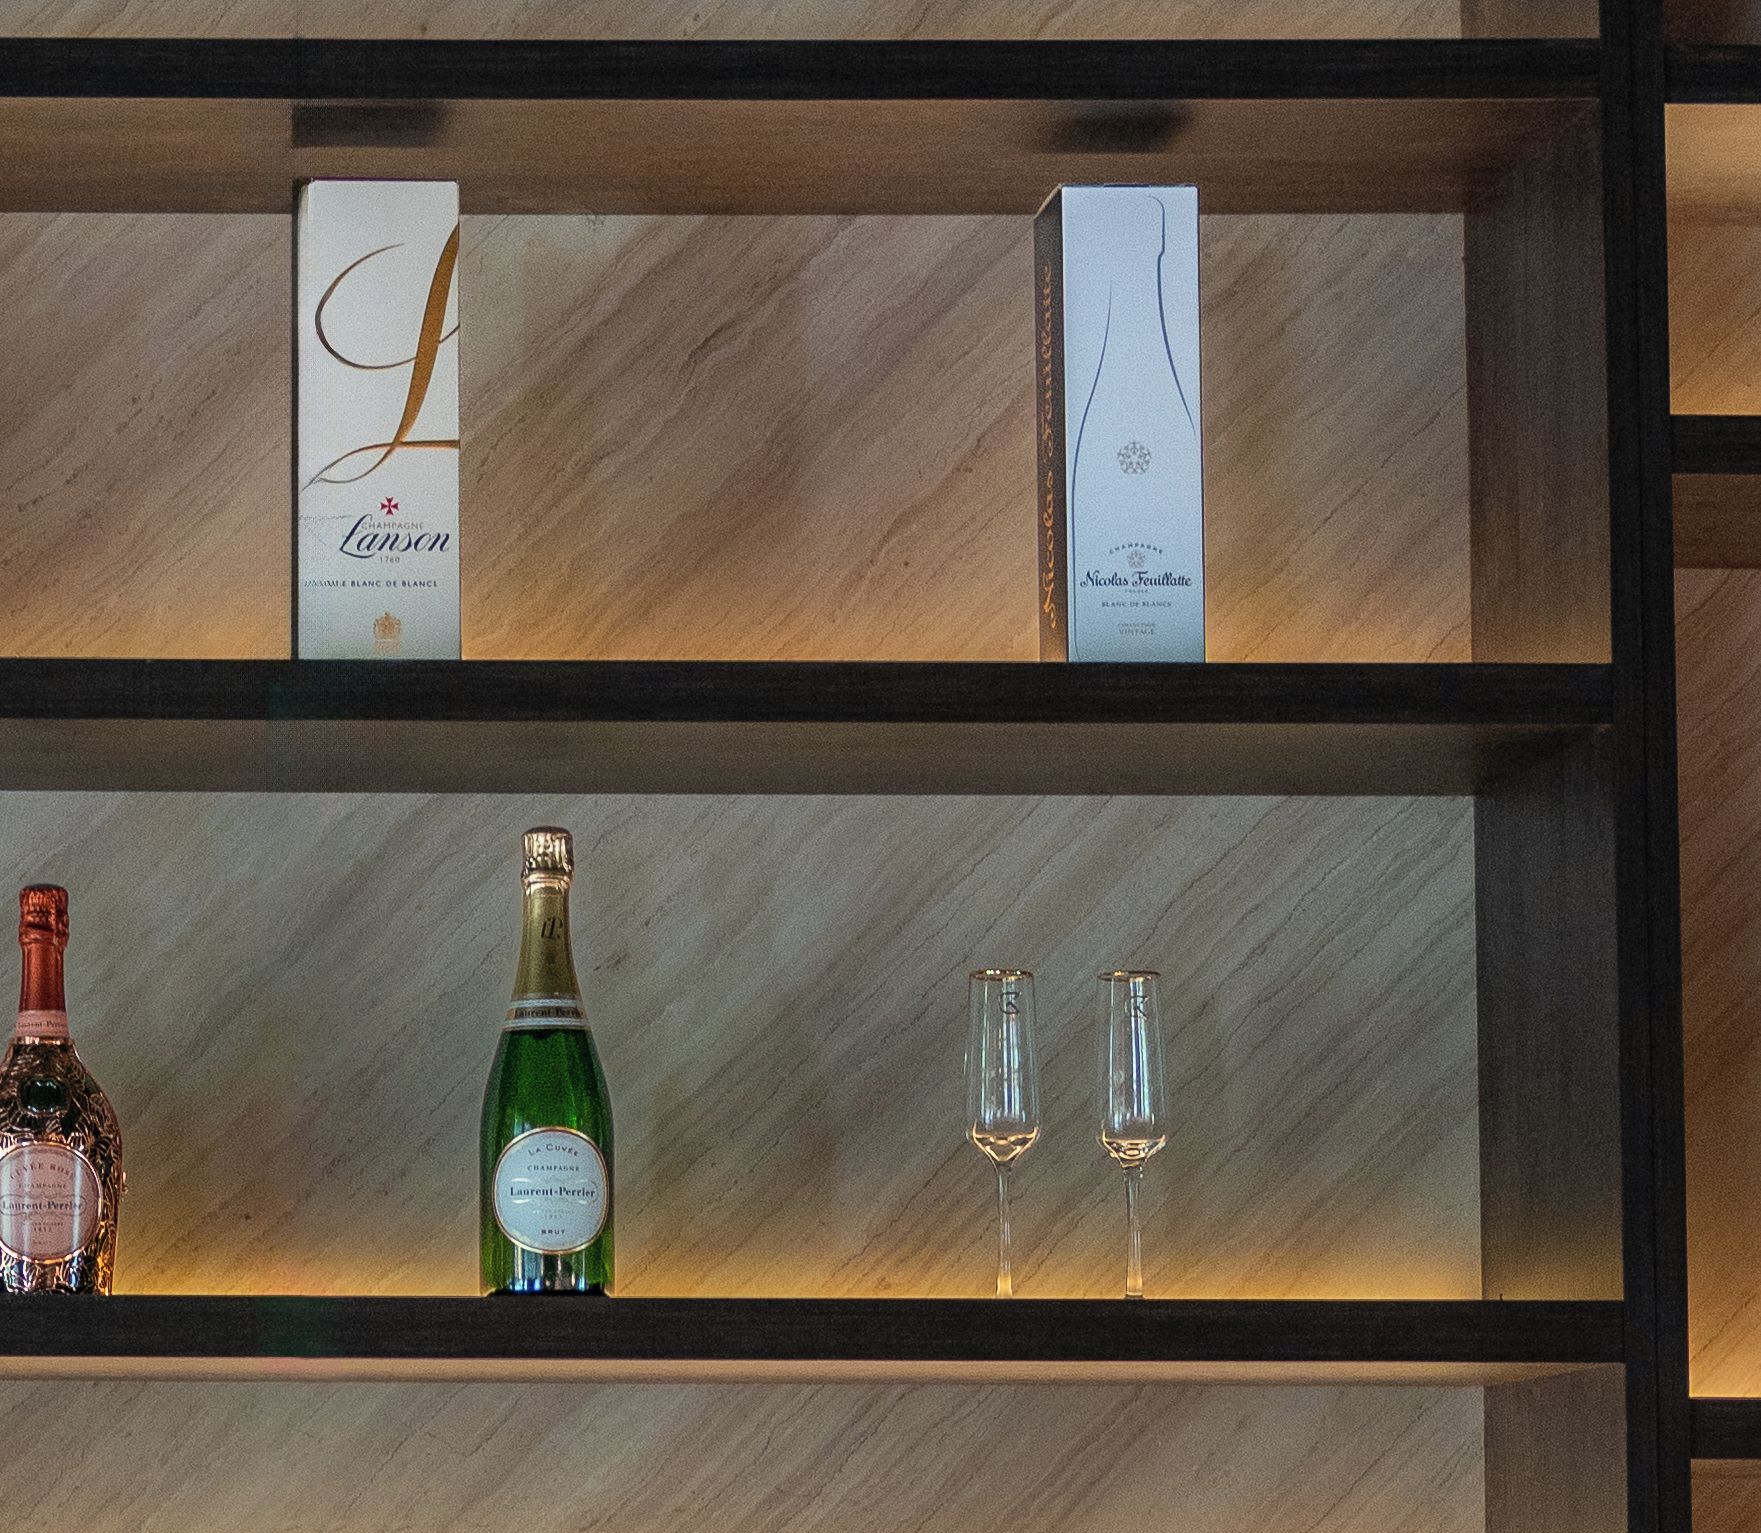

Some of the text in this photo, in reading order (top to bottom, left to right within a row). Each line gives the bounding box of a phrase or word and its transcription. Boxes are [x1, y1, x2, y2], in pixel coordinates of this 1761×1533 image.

[361, 521, 424, 531] CHAMPAGNE
[340, 513, 451, 559] Lanson
[350, 580, 381, 588] BLANC
[386, 580, 397, 588] DE
[1080, 570, 1192, 588] Nicolas Feuillatte
[509, 1186, 596, 1198] Laurent-Perrier
[2, 1200, 83, 1211] Laurent-Perrier
